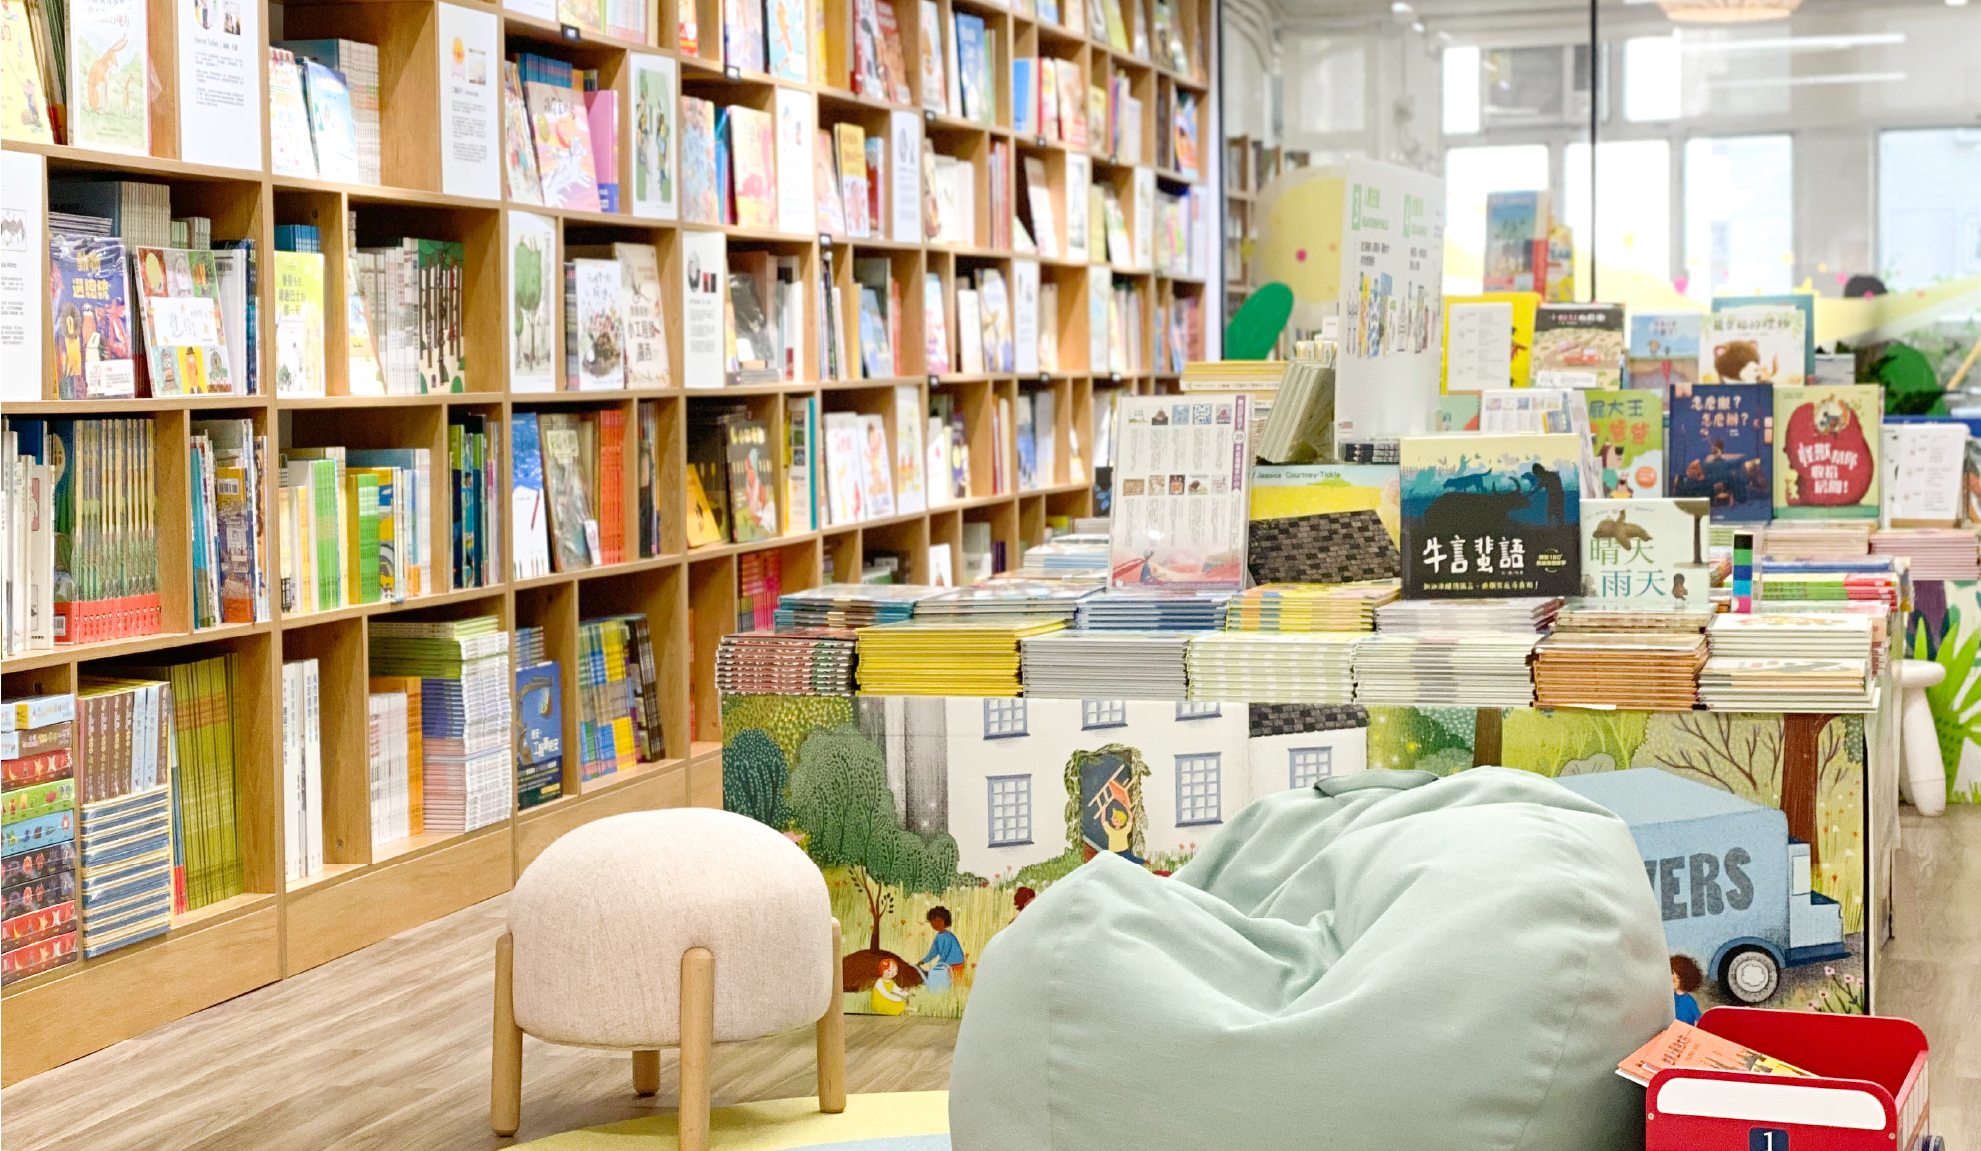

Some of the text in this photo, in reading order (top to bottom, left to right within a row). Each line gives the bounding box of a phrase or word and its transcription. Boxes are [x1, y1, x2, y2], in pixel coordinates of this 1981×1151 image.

[1422, 534, 1526, 574] 牛言蜚語
[1589, 538, 1655, 566] 晴天
[1600, 569, 1666, 598] 雨天
[1763, 1131, 1773, 1151] 1
